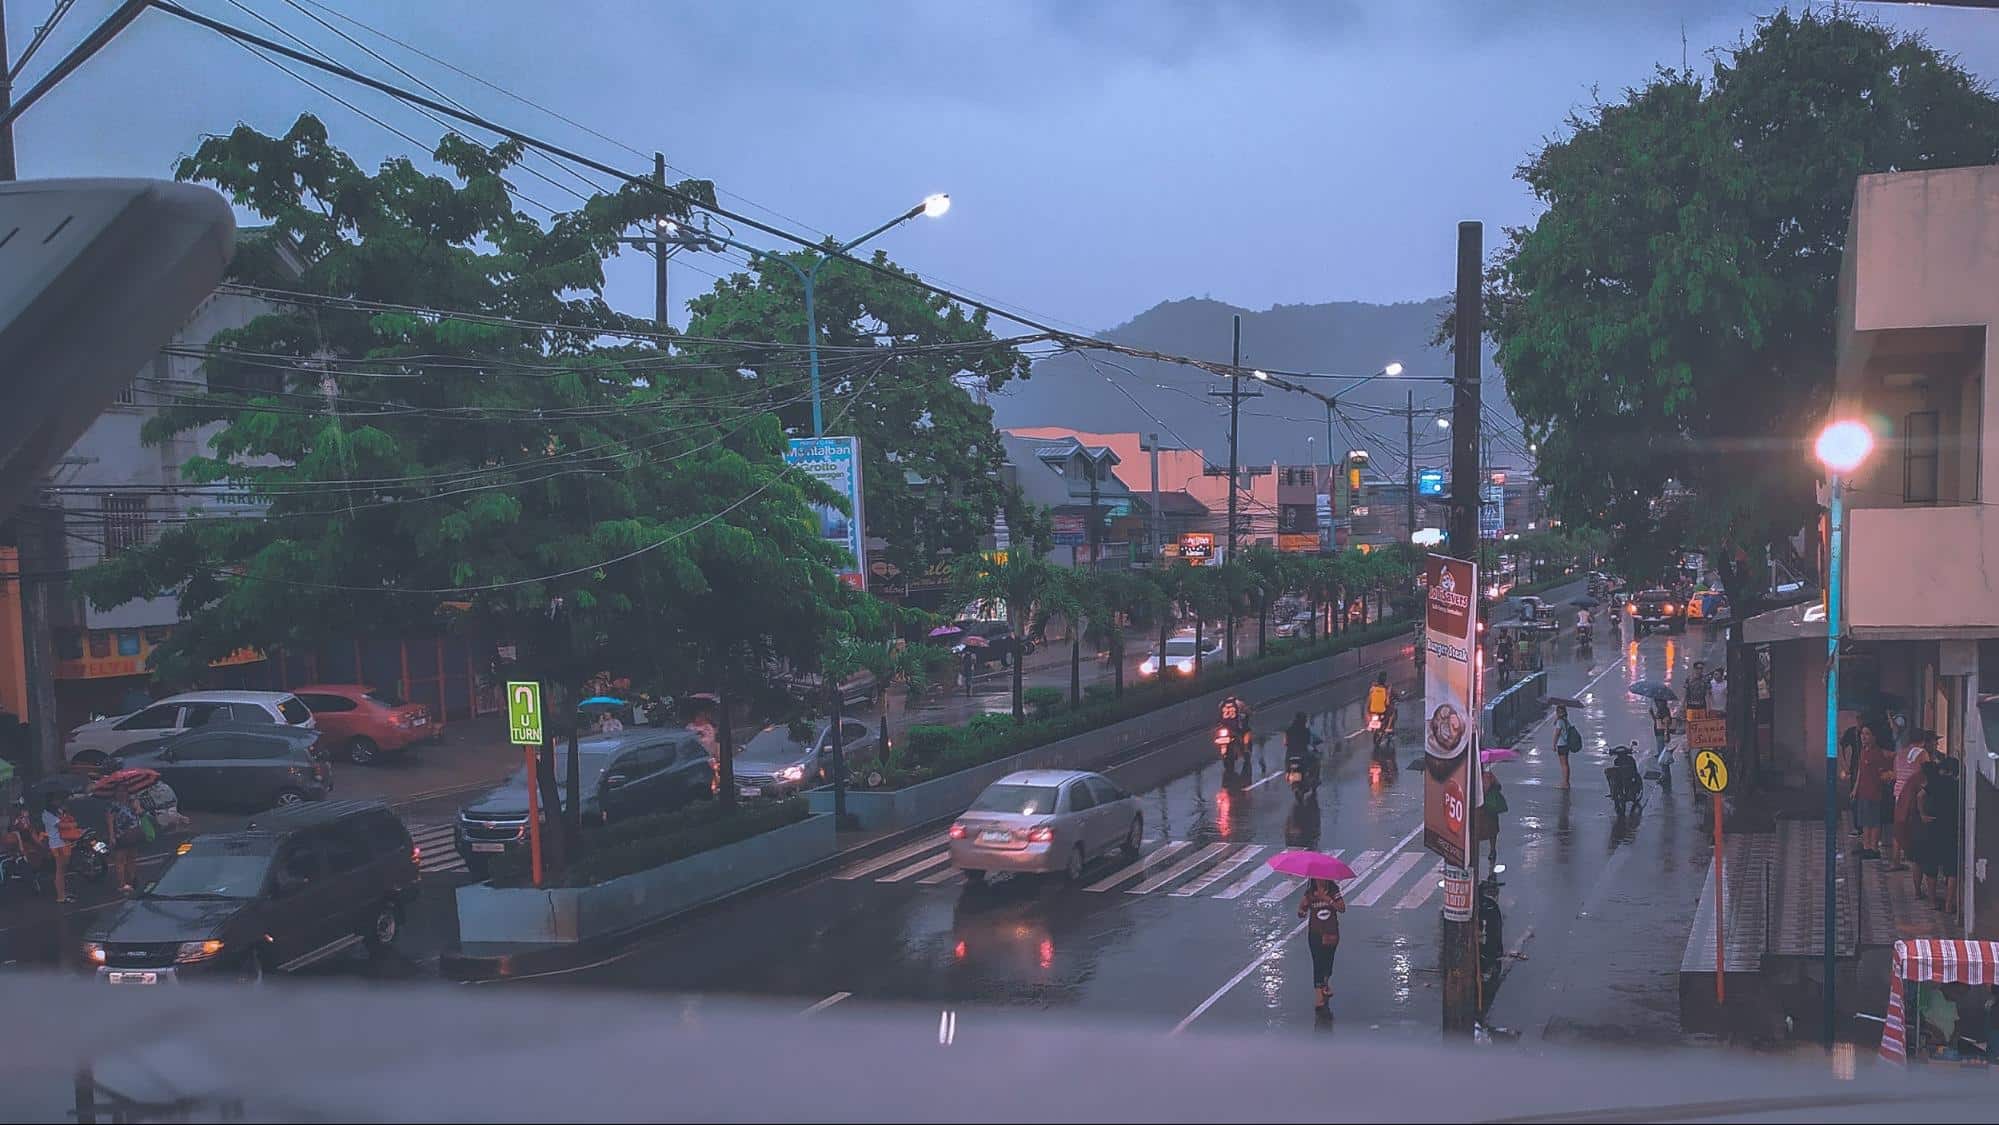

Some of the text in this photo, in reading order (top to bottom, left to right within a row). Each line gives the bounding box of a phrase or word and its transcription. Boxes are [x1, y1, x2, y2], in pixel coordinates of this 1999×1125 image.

[786, 445, 851, 458] Montalban
[521, 714, 530, 727] U
[512, 728, 540, 740] TURN
